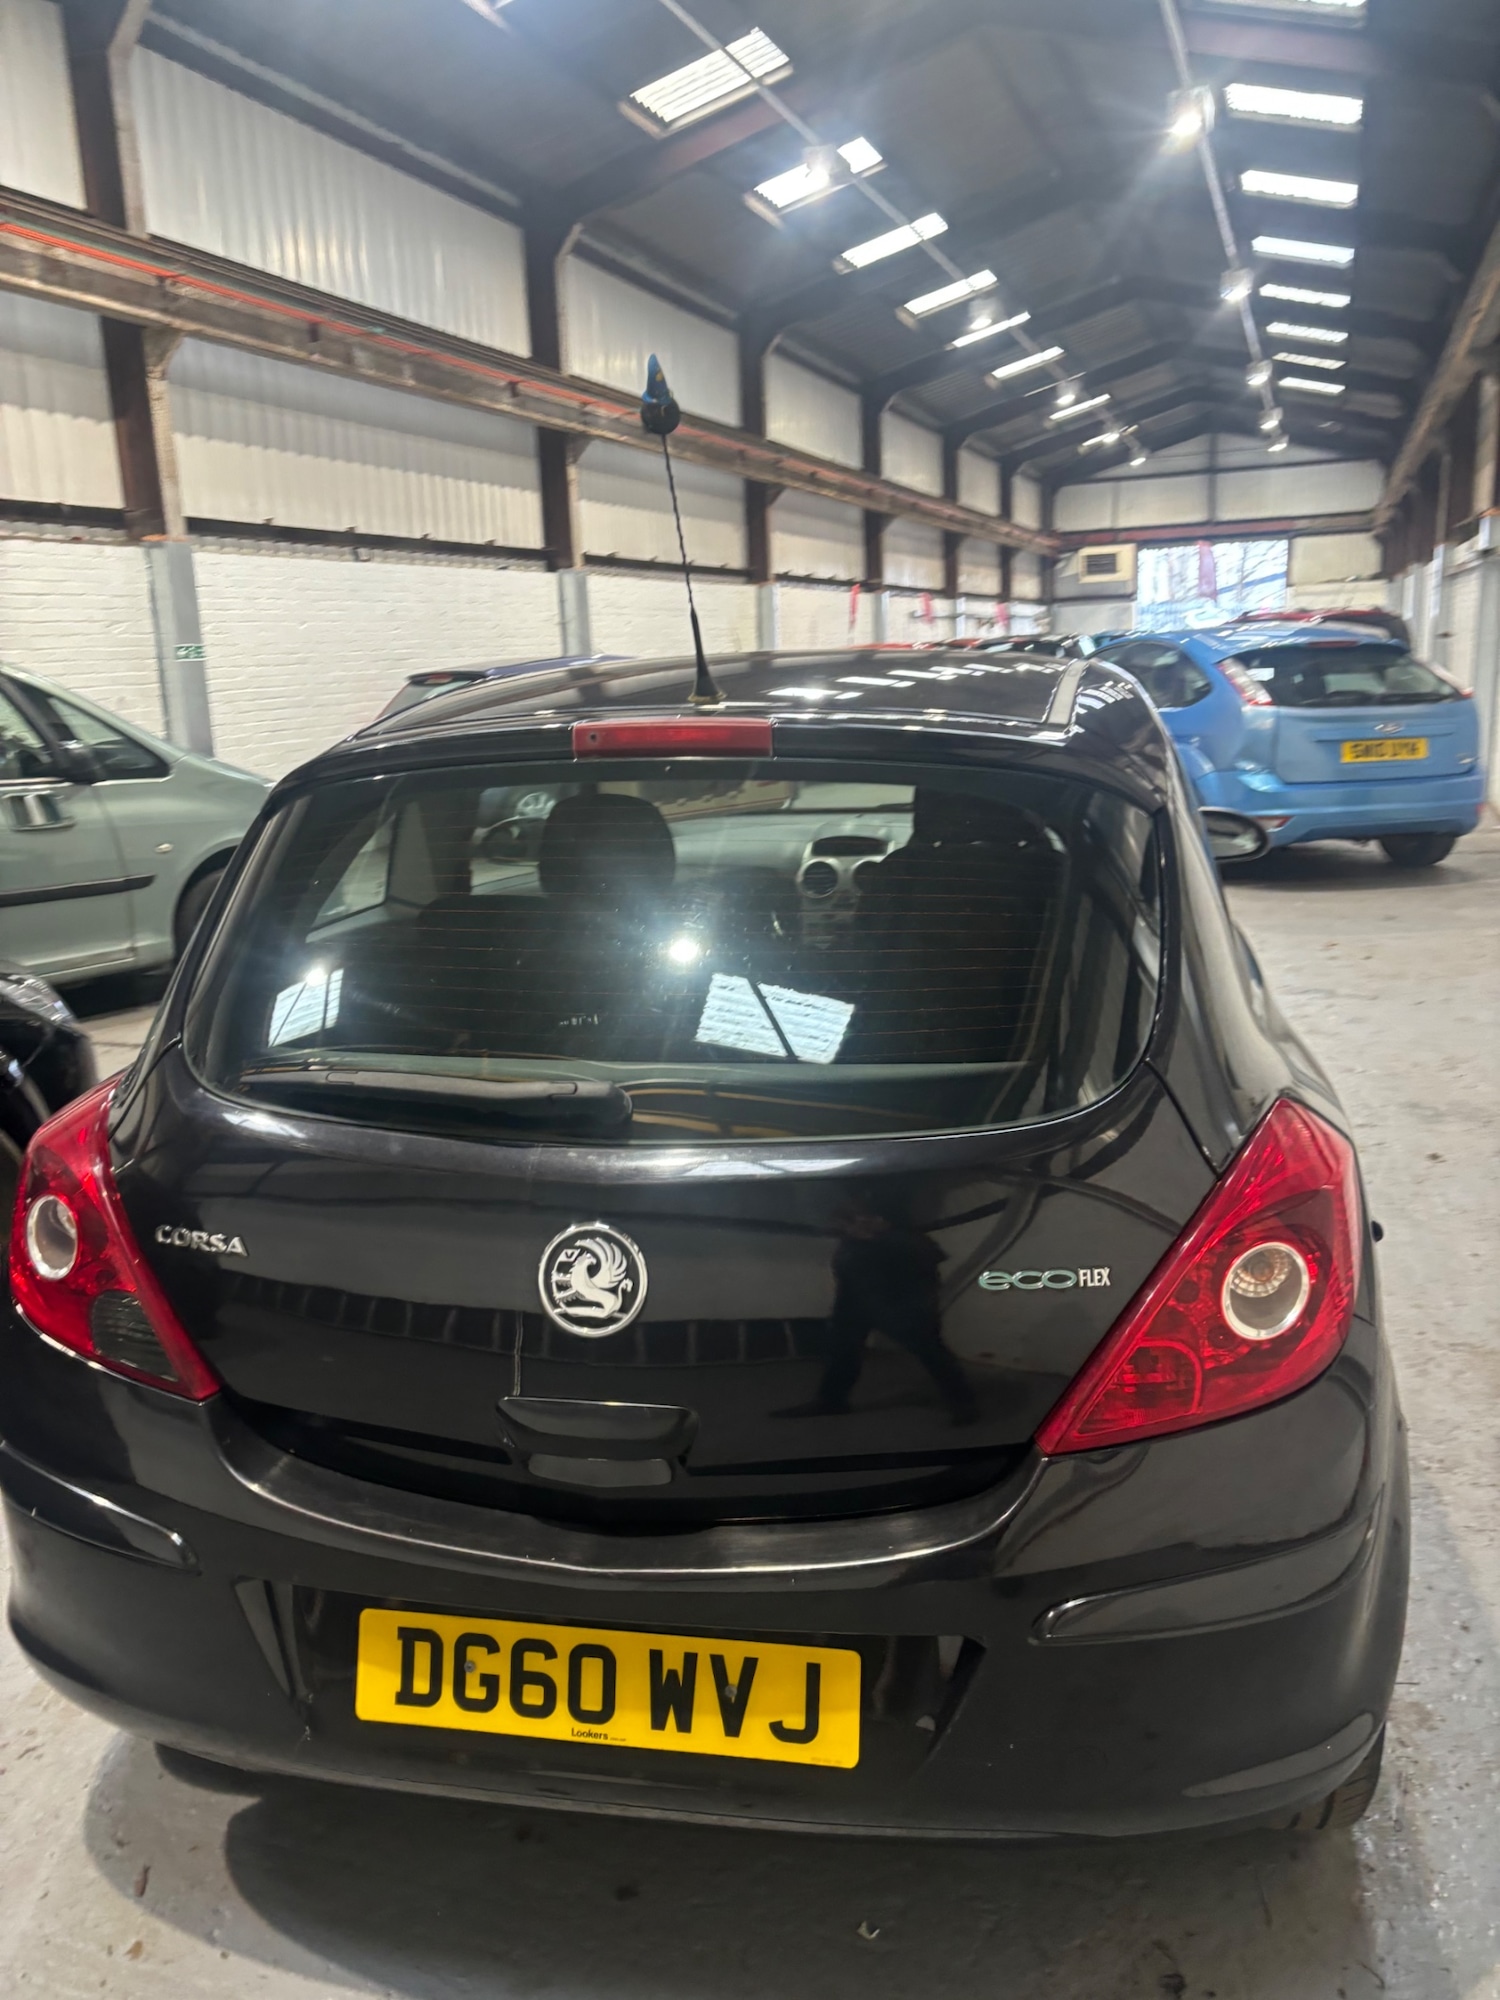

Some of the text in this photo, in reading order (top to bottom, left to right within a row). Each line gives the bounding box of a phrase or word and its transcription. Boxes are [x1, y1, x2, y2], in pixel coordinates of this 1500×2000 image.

[155, 1224, 248, 1257] CORSA
[395, 1626, 821, 1745] DG60 WVJ
[571, 1727, 608, 1740] Lookers
